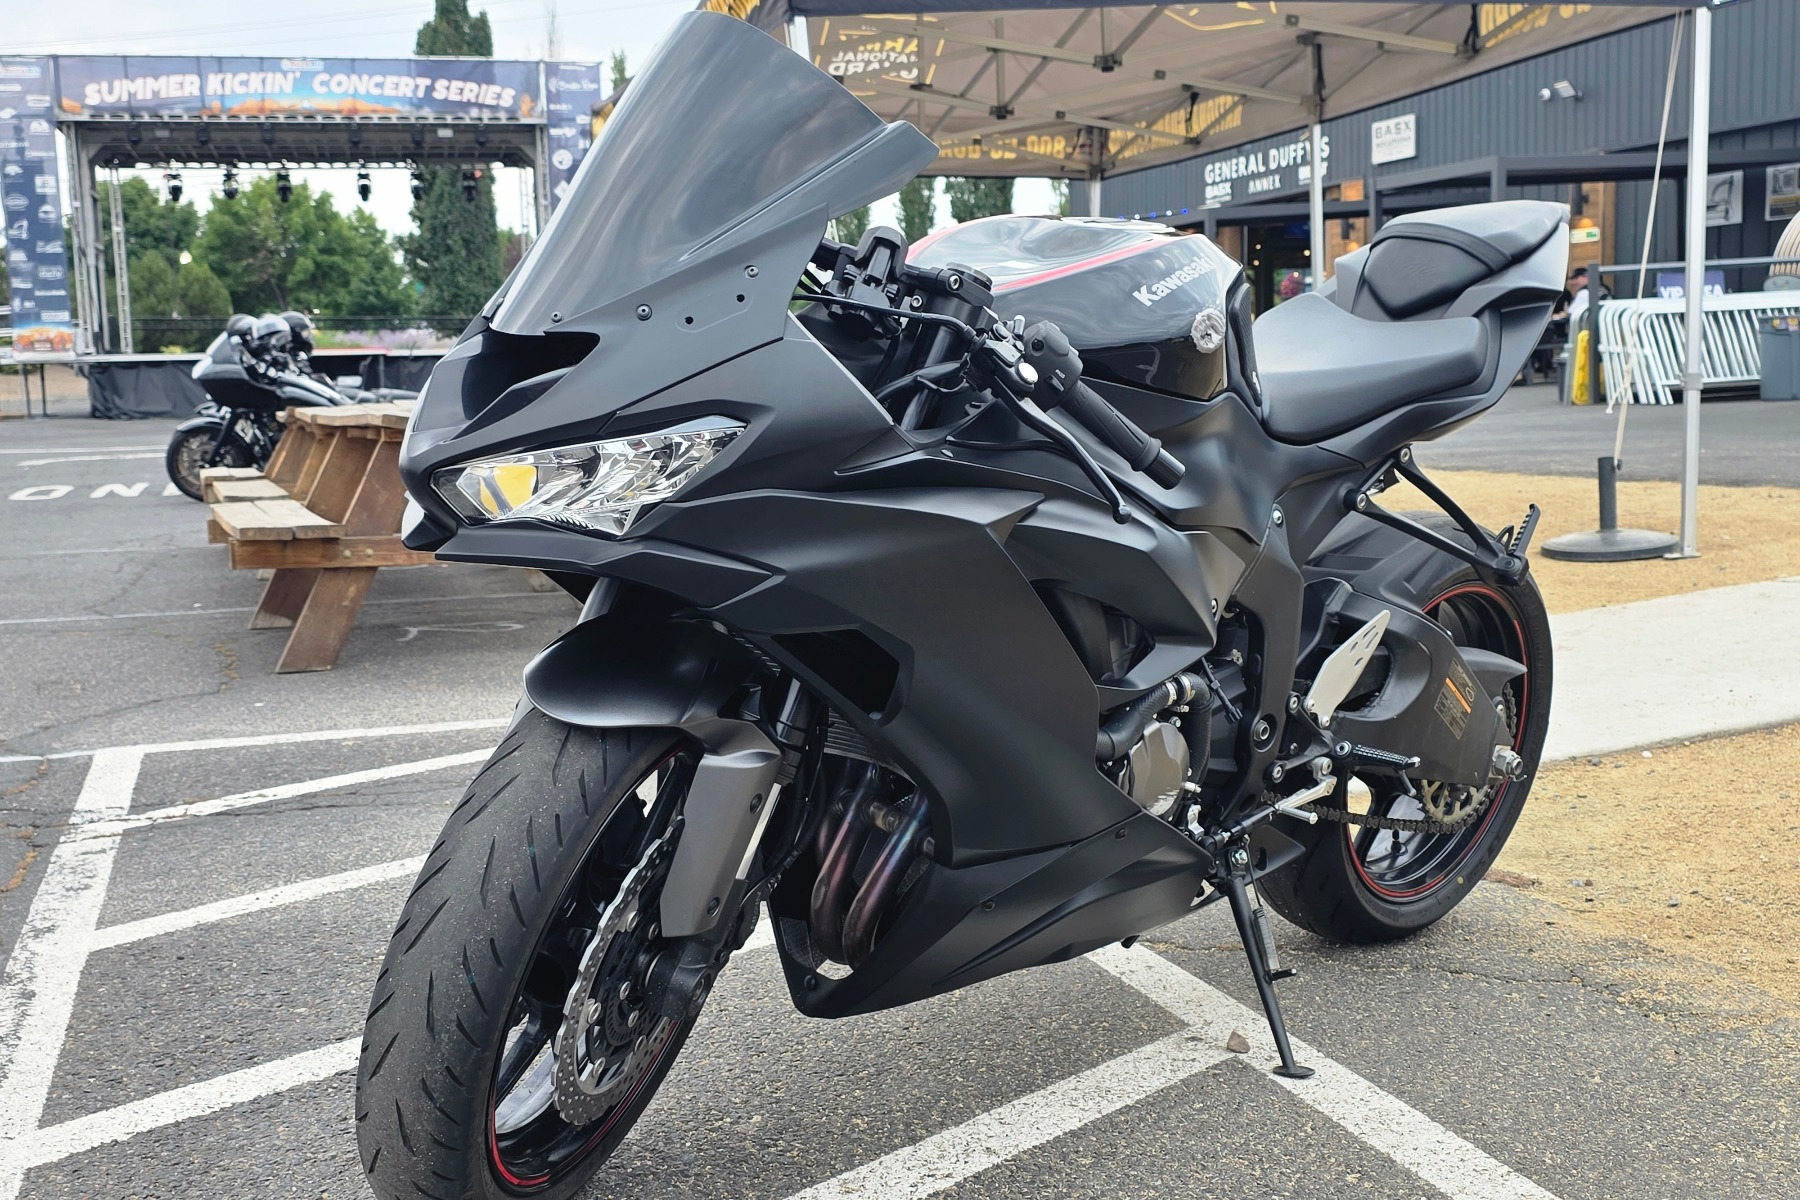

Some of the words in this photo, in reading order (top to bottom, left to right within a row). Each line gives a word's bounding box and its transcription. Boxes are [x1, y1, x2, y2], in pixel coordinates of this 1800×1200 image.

[84, 73, 201, 106] SUMMER
[206, 71, 301, 96] KICKIN'
[312, 72, 431, 99] CONCERT
[432, 78, 517, 108] SERIES
[1204, 151, 1266, 184] GENERAL
[1248, 173, 1281, 195] ANNEX
[1132, 253, 1217, 307] Kawasaki
